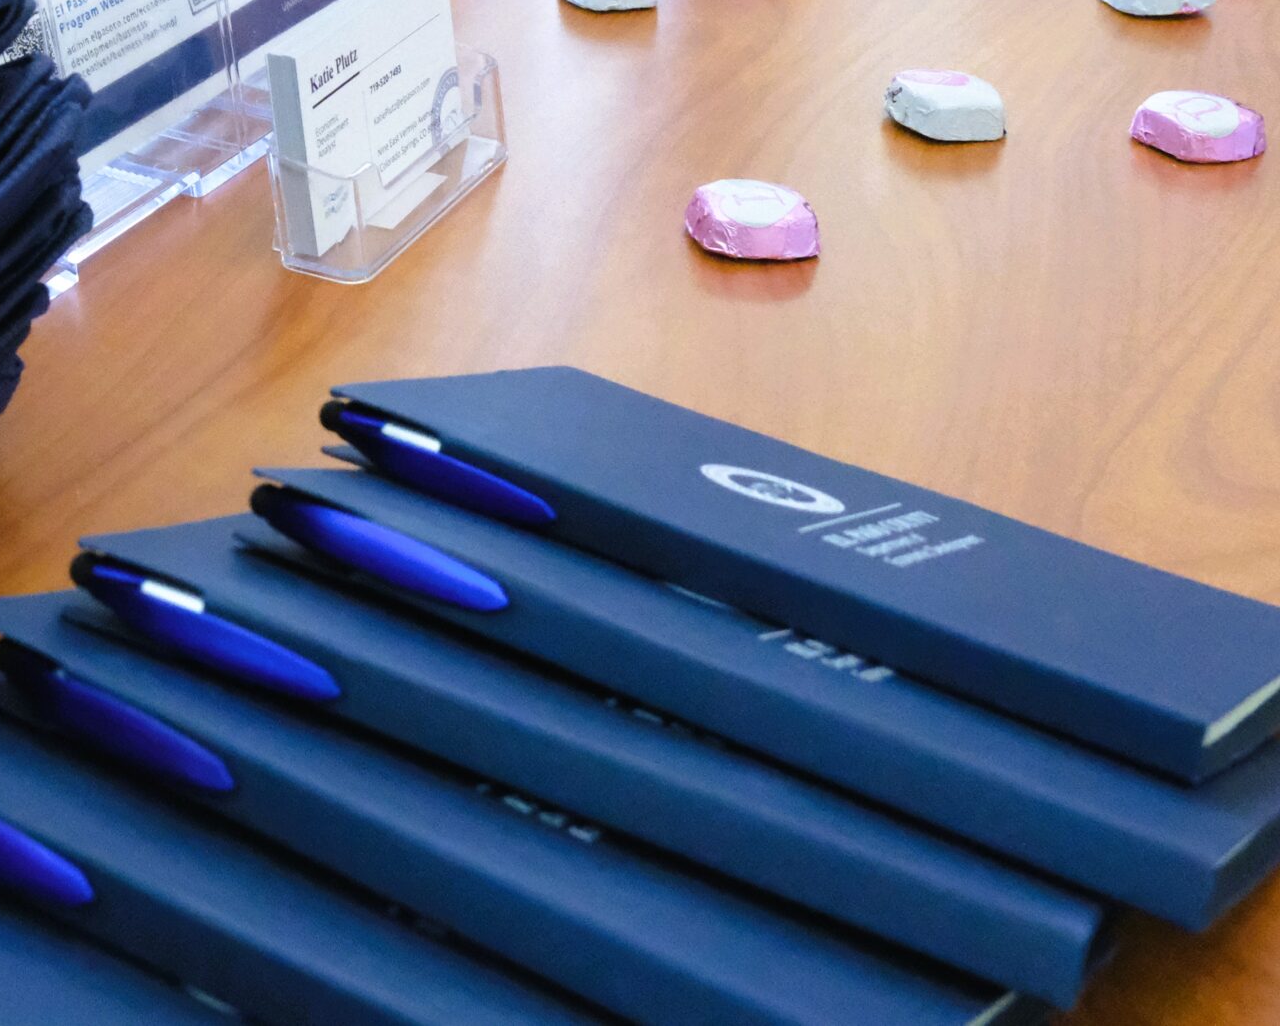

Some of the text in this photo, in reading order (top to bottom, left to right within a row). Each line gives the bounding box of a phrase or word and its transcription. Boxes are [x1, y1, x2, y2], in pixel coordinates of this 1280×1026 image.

[59, 6, 100, 34] Program
[310, 49, 360, 94] Katie Plutz
